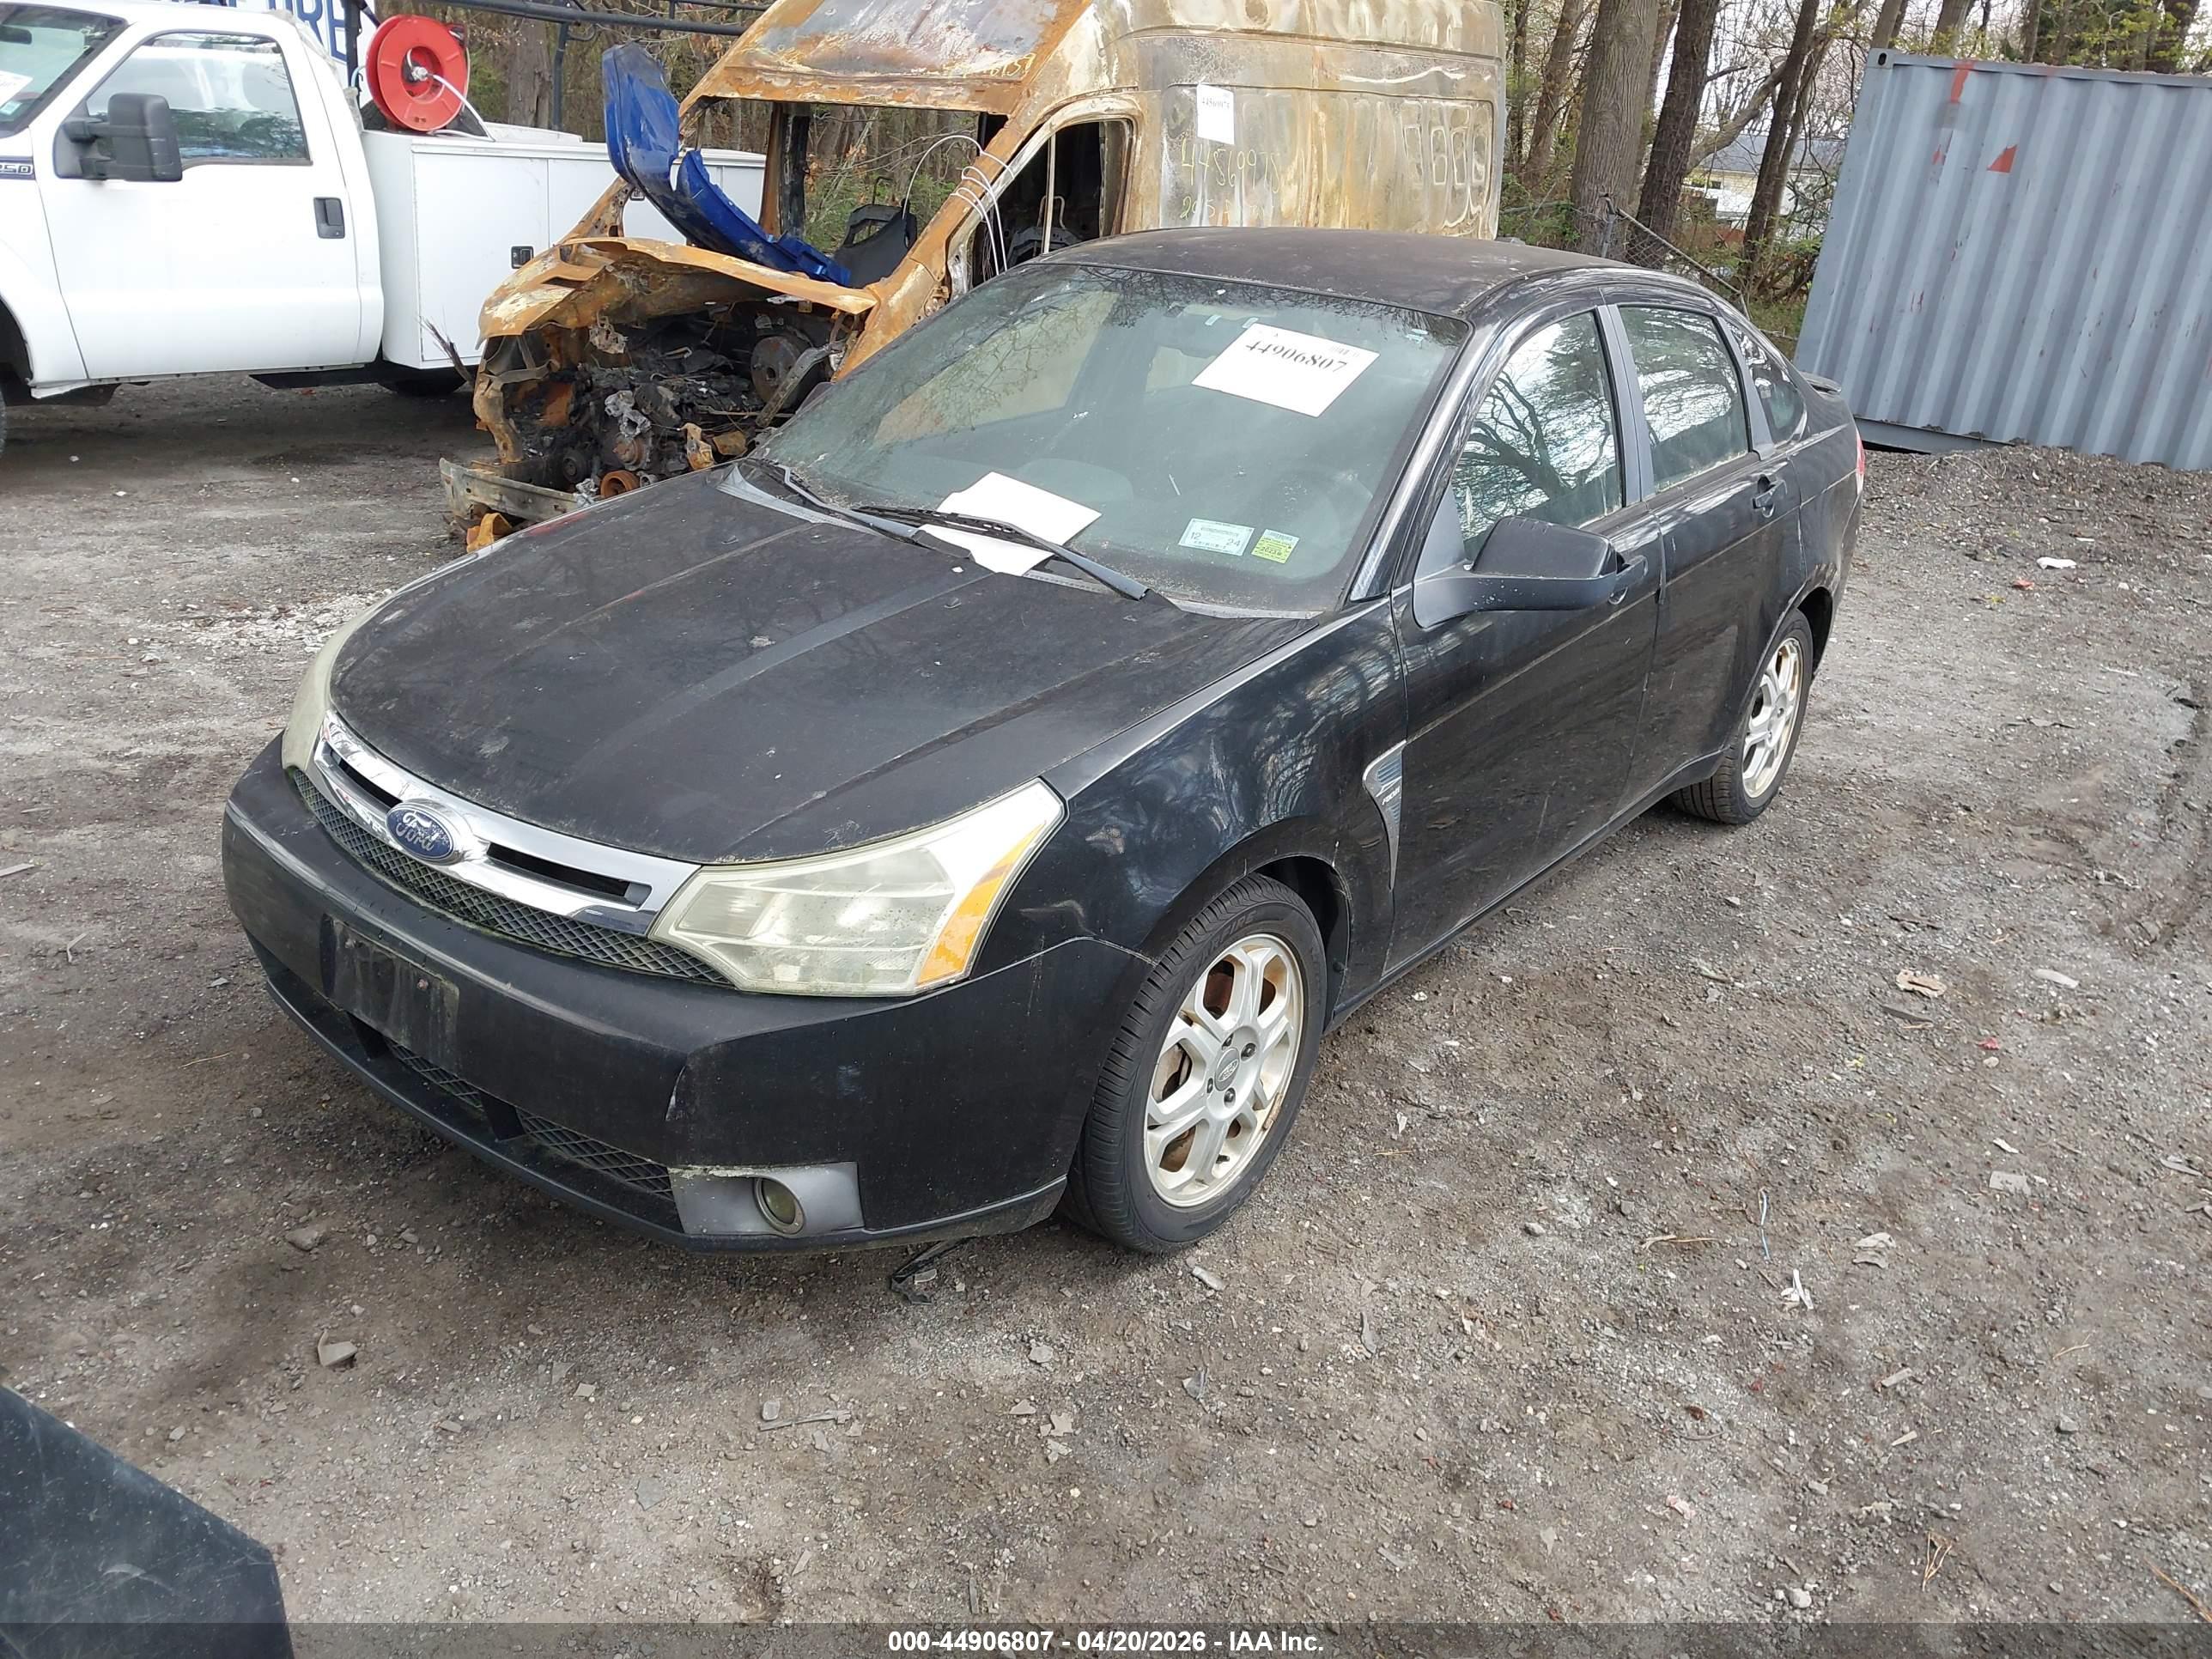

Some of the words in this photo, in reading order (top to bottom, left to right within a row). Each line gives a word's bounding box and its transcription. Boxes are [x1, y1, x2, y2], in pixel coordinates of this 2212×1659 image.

[0, 162, 33, 175] 50
[1180, 196, 1216, 219] 205
[1245, 341, 1347, 373] 44906807
[396, 811, 440, 851] Ford
